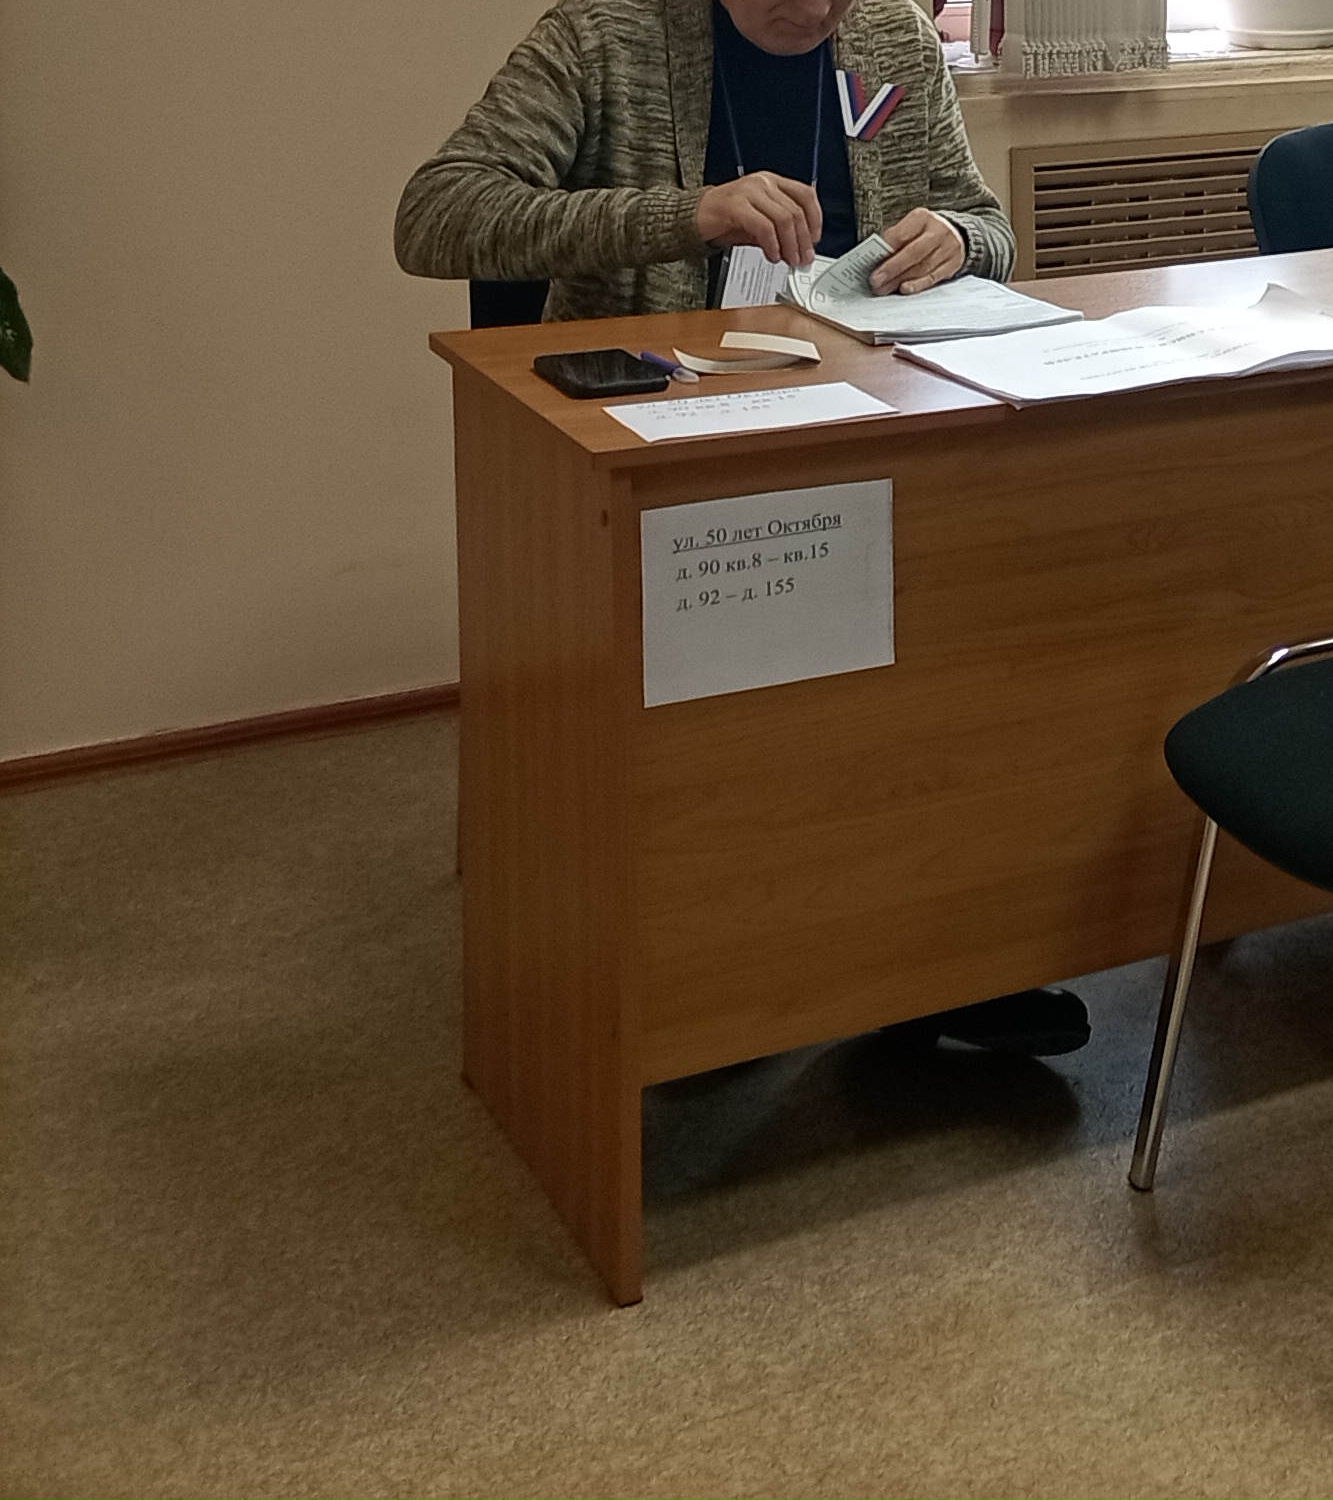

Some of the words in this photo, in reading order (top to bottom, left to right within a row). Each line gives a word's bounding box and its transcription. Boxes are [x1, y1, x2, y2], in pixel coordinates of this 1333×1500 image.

[673, 536, 700, 551] ул.
[706, 527, 728, 546] 50
[732, 526, 763, 542] лет
[767, 513, 842, 535] Октября
[676, 566, 693, 582] д.
[698, 558, 721, 577] 90
[725, 552, 762, 573] кв.8
[783, 541, 830, 564] кв.15
[676, 597, 693, 612] д.
[698, 589, 721, 607] 92
[741, 587, 758, 602] д.
[765, 577, 796, 597] 155
